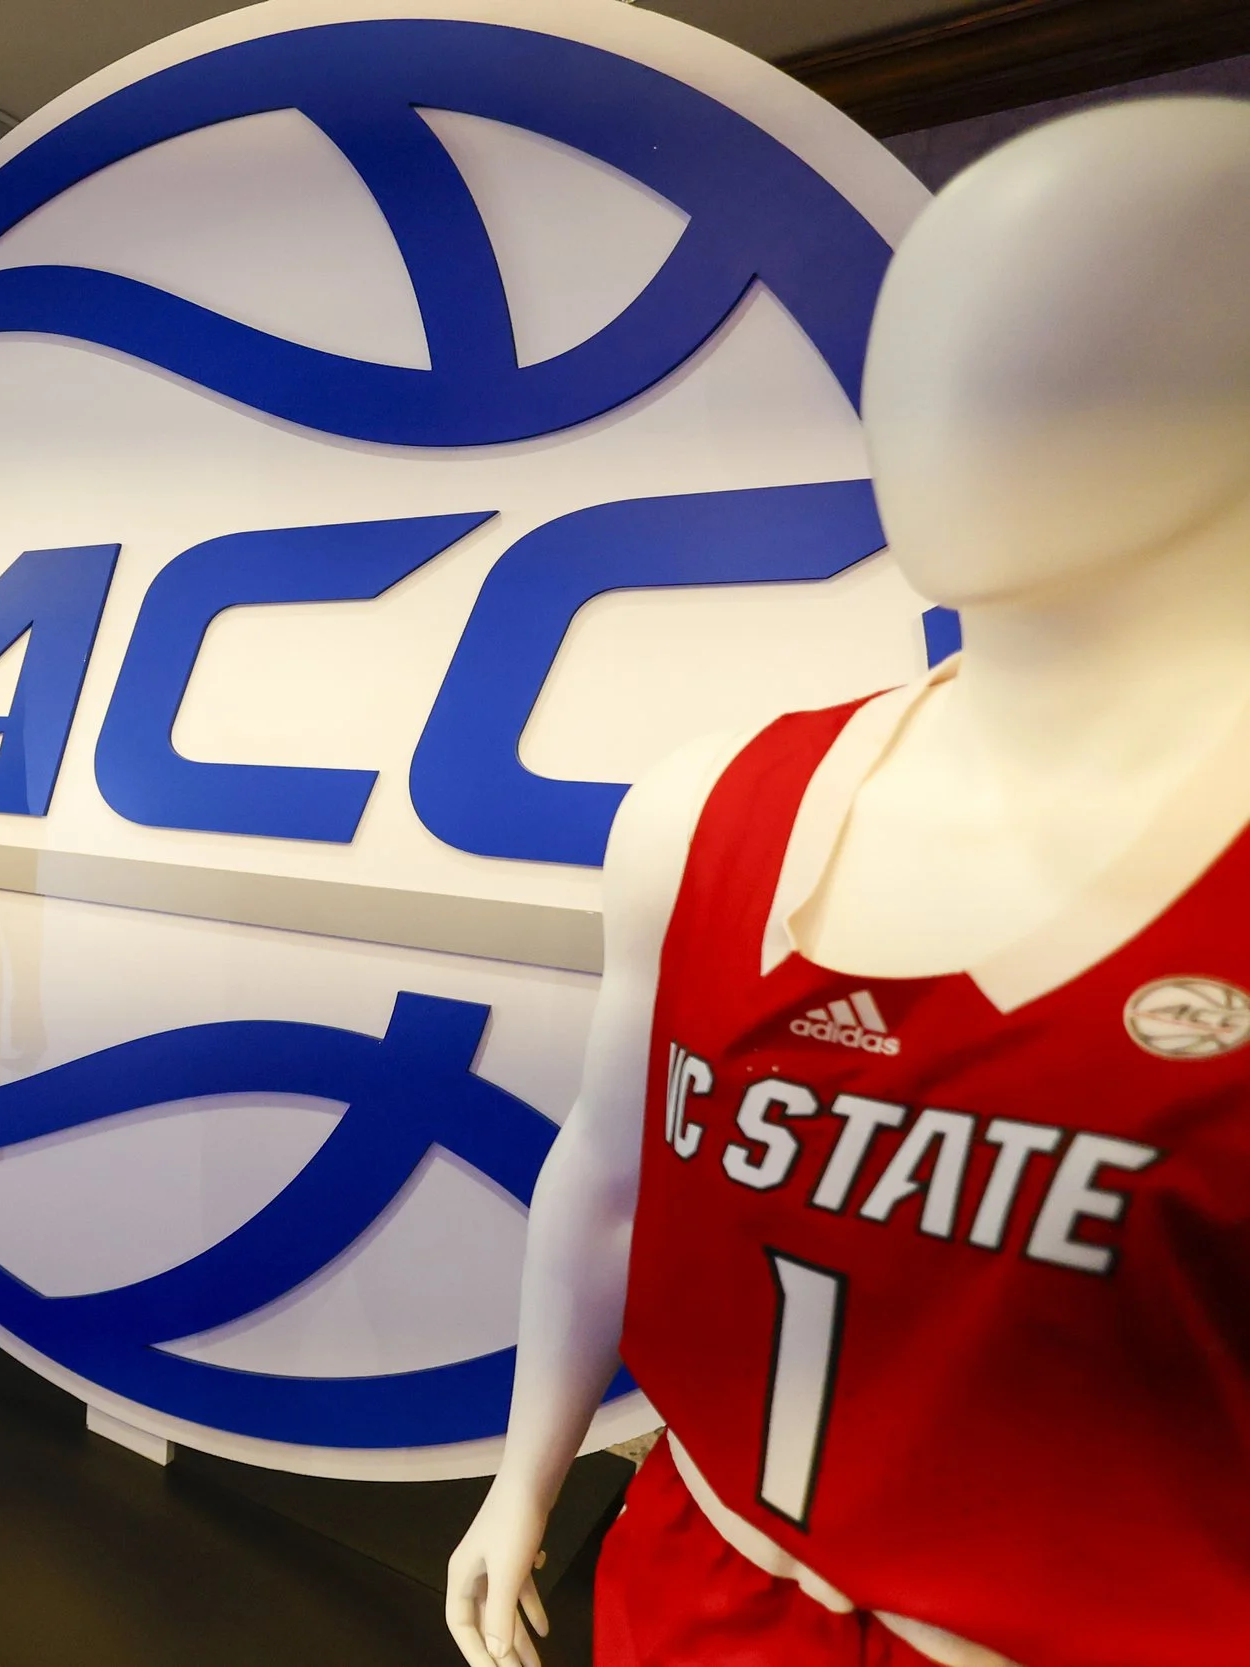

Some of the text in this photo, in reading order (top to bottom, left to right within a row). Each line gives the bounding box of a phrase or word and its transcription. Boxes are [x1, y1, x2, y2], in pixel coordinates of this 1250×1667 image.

[789, 1017, 901, 1057] adidas
[720, 1075, 1167, 1279] STATE
[755, 1243, 848, 1536] 1
